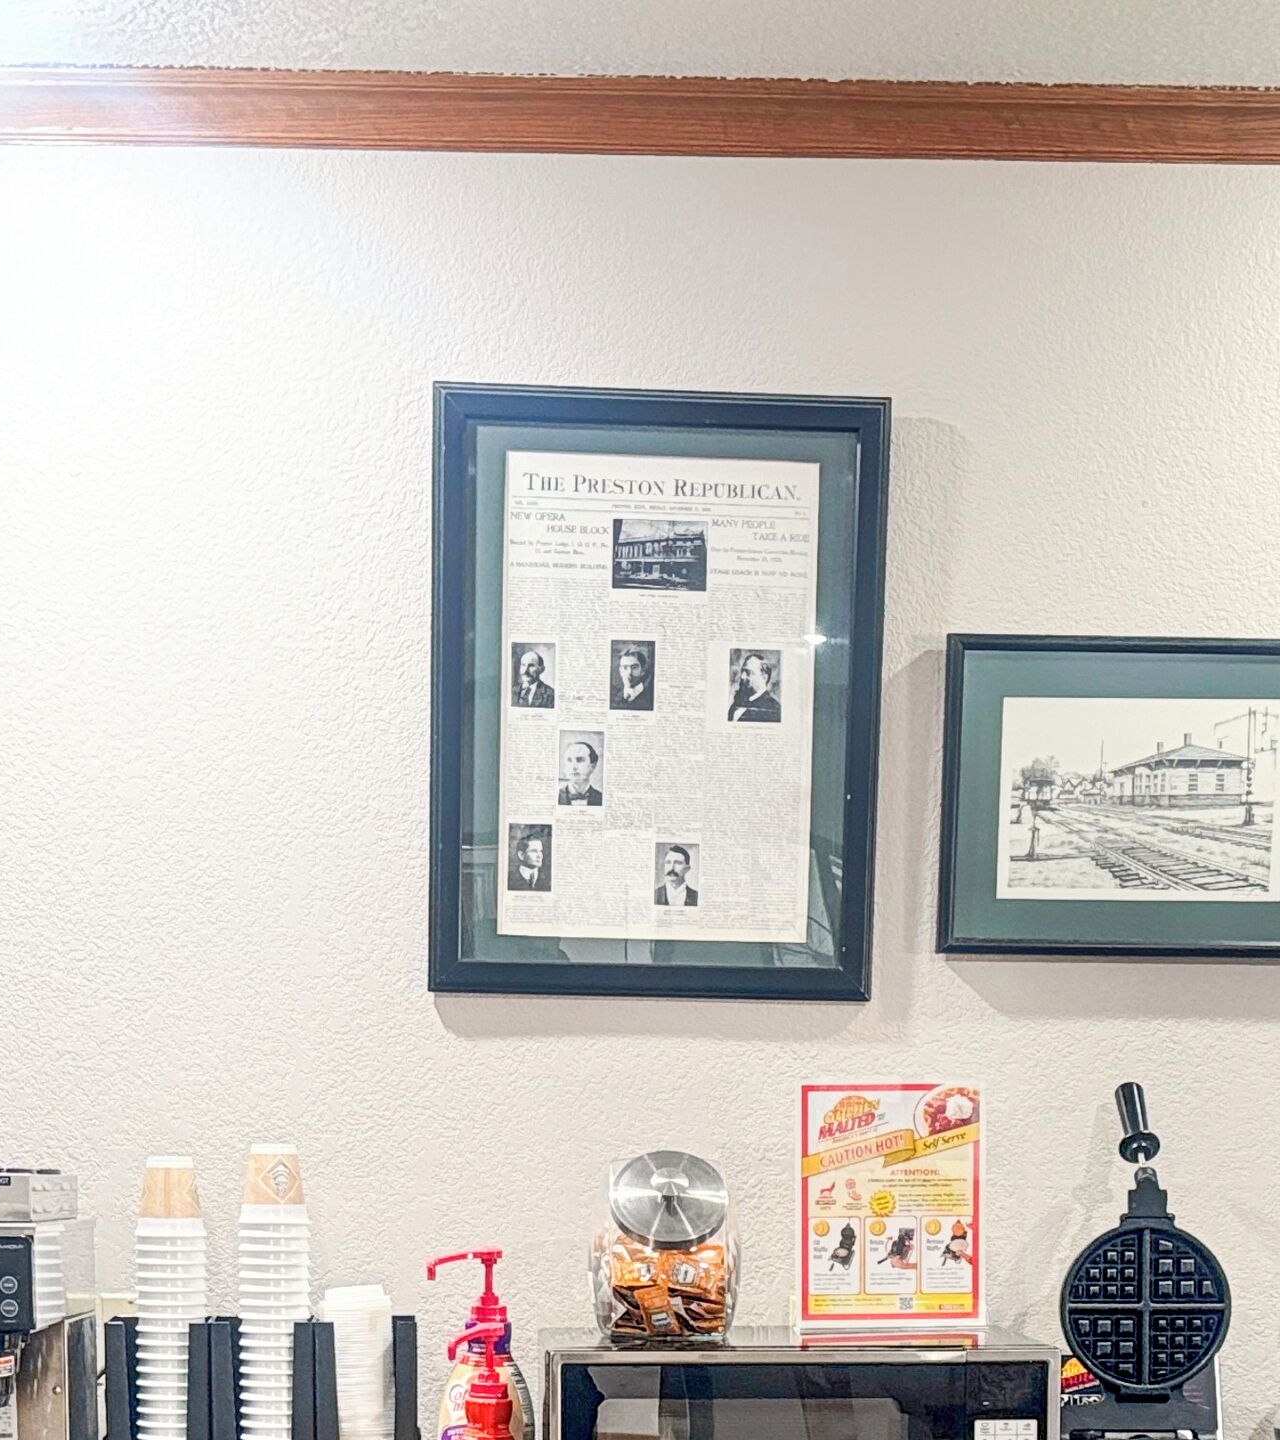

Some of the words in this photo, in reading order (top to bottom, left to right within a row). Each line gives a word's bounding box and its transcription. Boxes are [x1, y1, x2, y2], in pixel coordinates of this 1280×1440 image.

[522, 472, 565, 492] THE
[572, 474, 665, 496] PRESTON
[818, 1112, 876, 1140] MALTED
[820, 1143, 873, 1168] CAUTION
[875, 1134, 905, 1153] HOT!
[922, 1138, 940, 1151] Self
[941, 1132, 967, 1145] Serve
